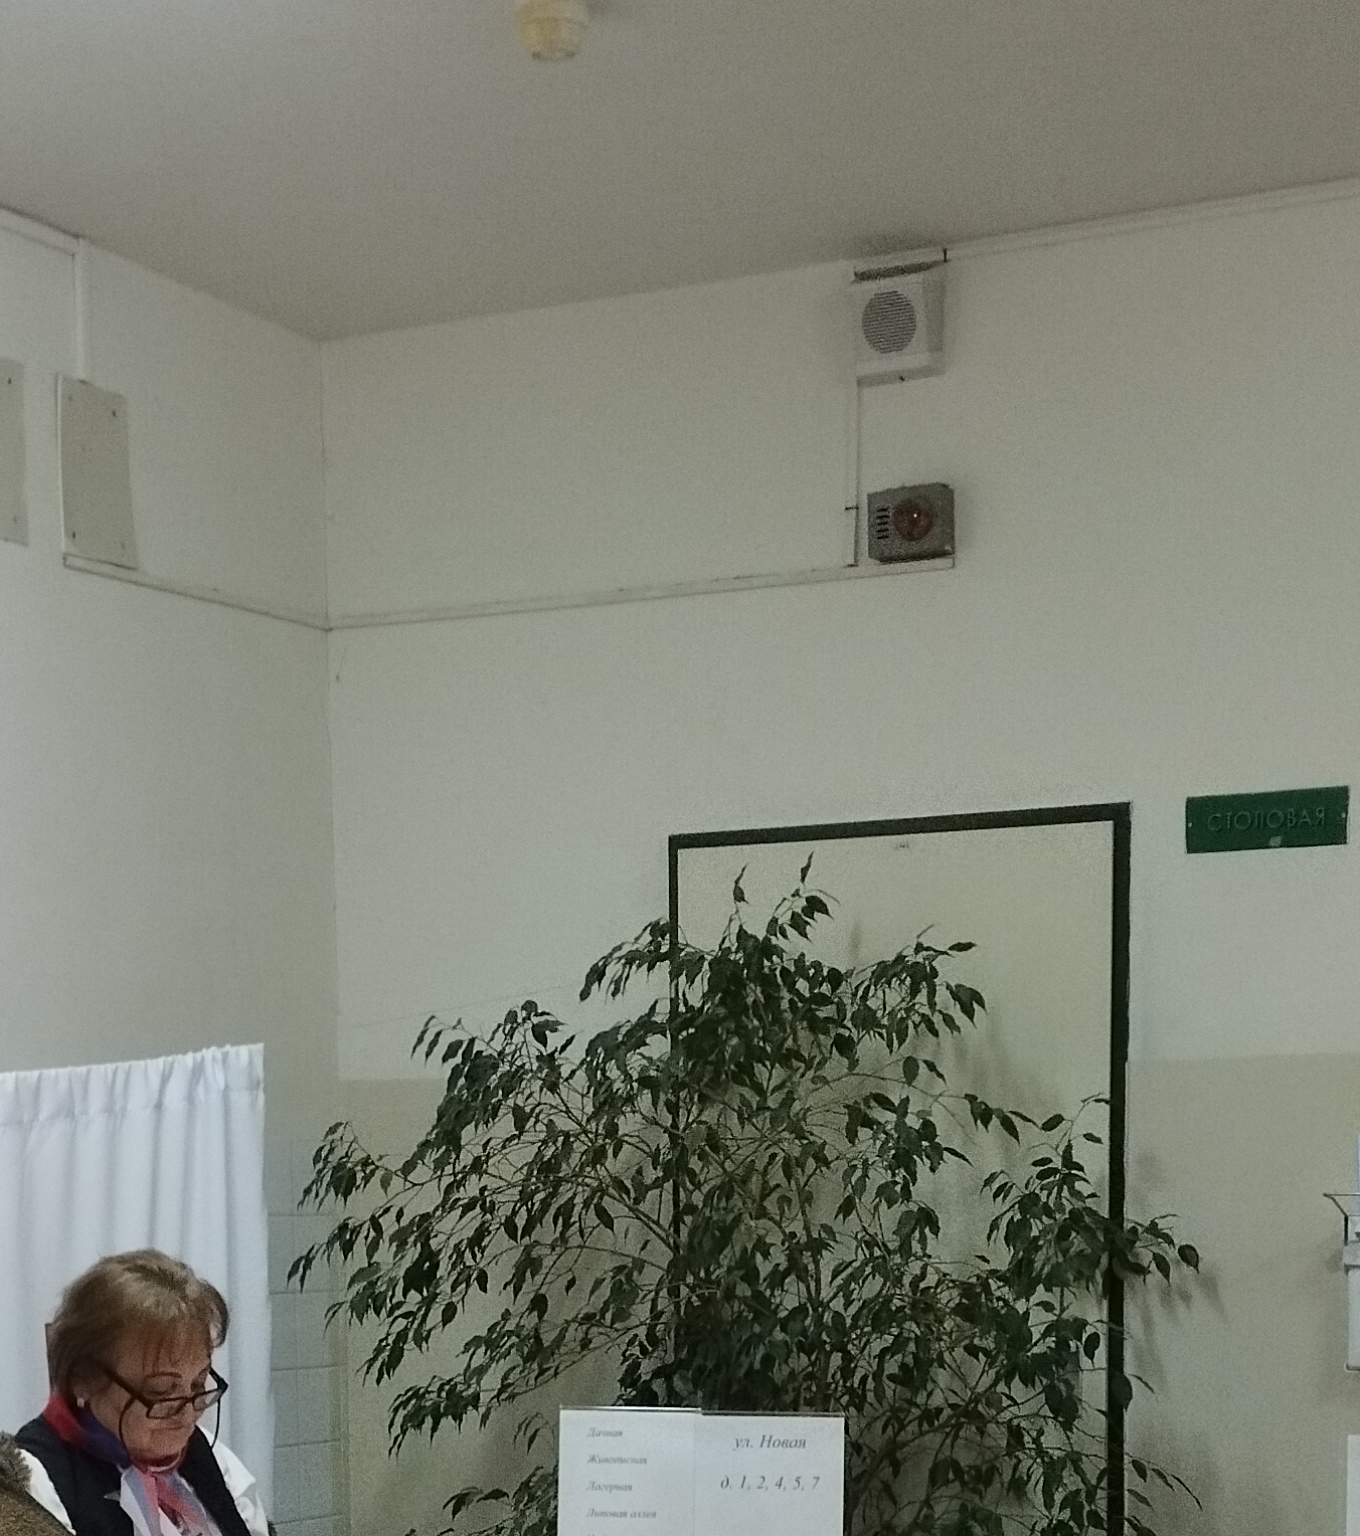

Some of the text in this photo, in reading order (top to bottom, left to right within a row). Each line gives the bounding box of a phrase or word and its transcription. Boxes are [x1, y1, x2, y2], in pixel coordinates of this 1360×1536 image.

[1207, 807, 1325, 831] СТОЛОВАЯ
[732, 1434, 807, 1452] ул. Новая
[720, 1475, 821, 1492] д. 1, 2, 4, 5, 7
